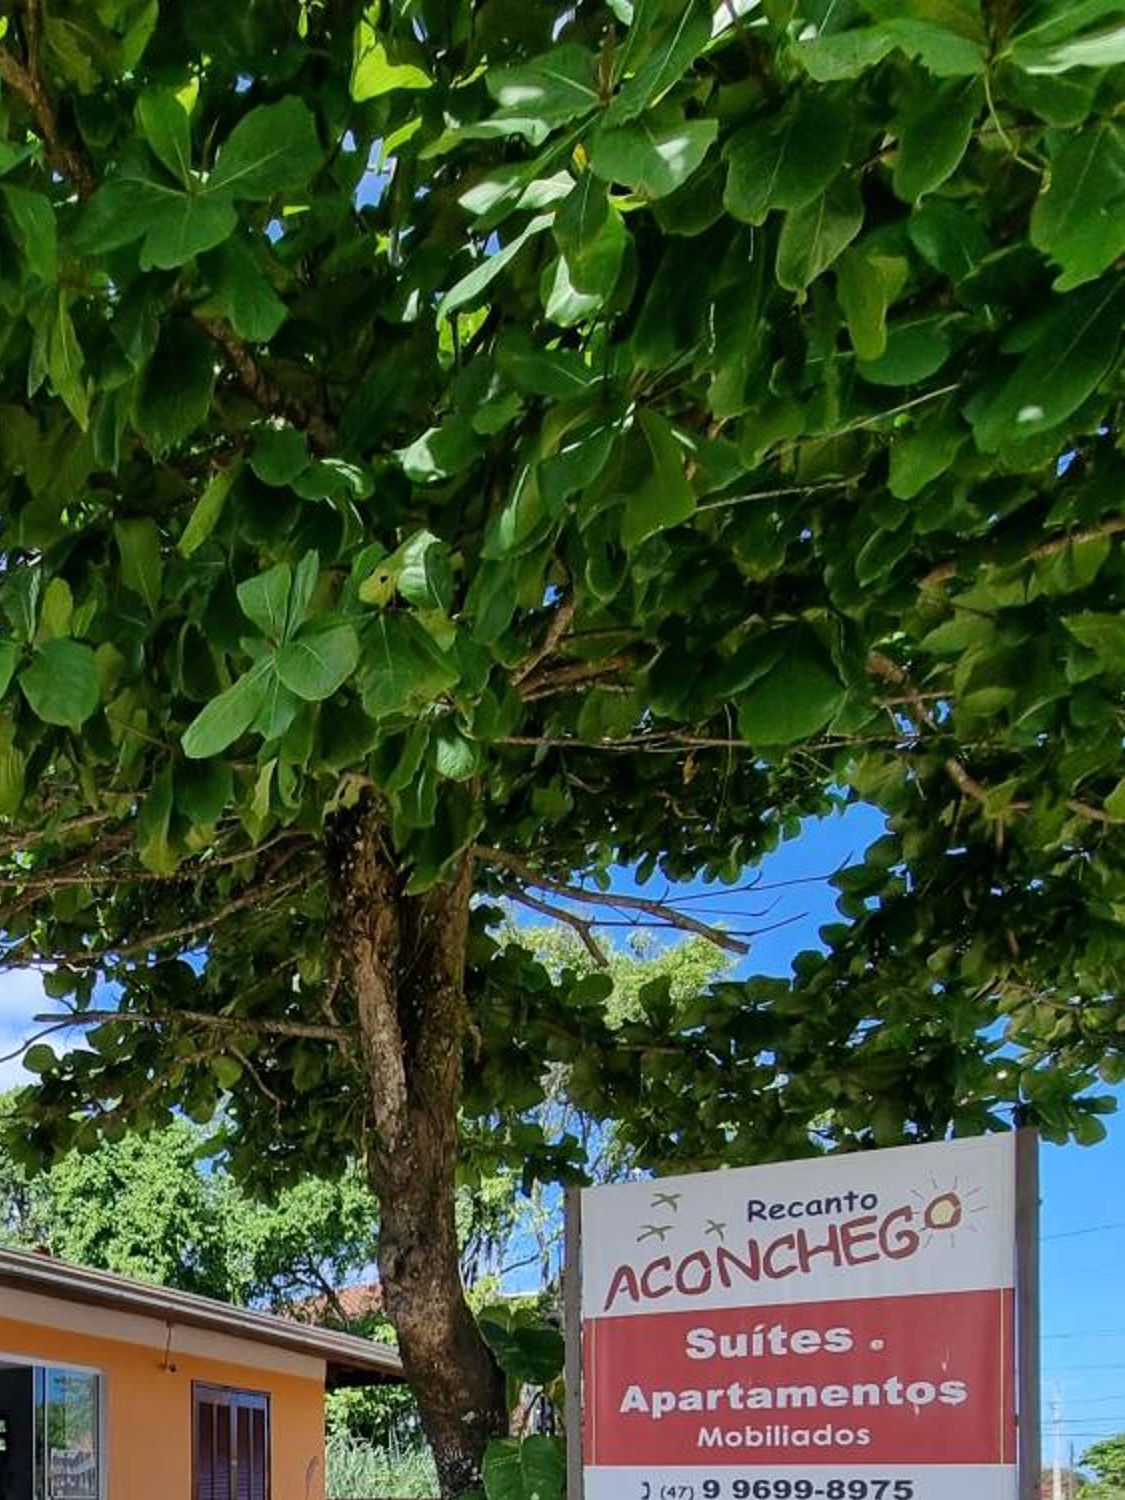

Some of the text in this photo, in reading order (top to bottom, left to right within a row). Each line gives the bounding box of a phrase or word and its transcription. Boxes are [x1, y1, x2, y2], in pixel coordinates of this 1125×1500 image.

[748, 1190, 878, 1222] Recanto
[604, 1191, 962, 1311] ACONCHEGO
[686, 1324, 853, 1359] Suítes
[620, 1376, 968, 1418] Apartamentos
[698, 1424, 871, 1448] Mobiliados
[660, 1479, 914, 1500] (47) 9 9699-8975
